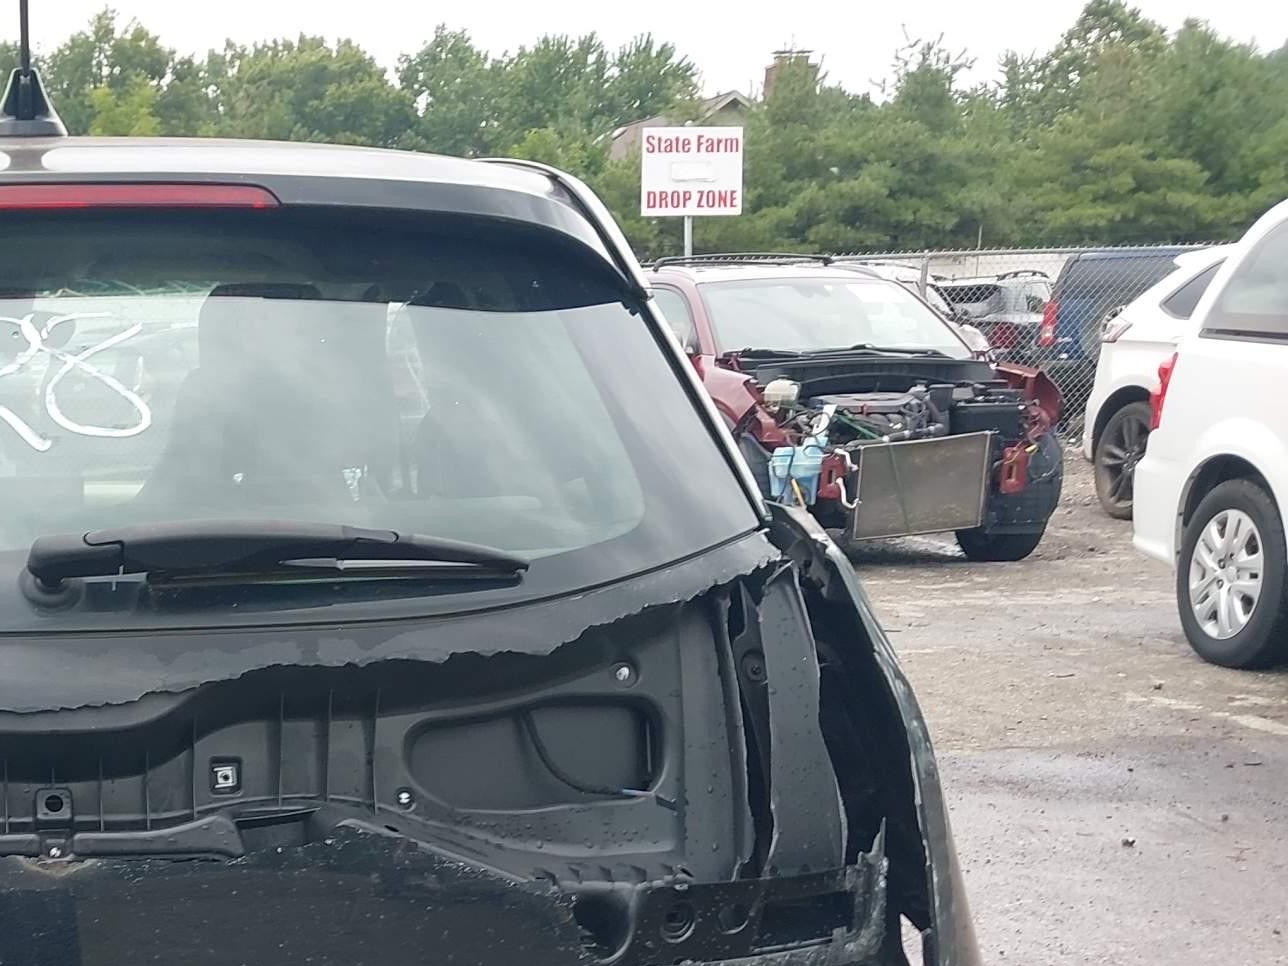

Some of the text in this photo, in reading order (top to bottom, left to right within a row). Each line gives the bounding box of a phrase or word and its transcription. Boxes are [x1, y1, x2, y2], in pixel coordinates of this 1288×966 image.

[646, 134, 739, 154] State Farm
[646, 189, 737, 209] DROP ZONE
